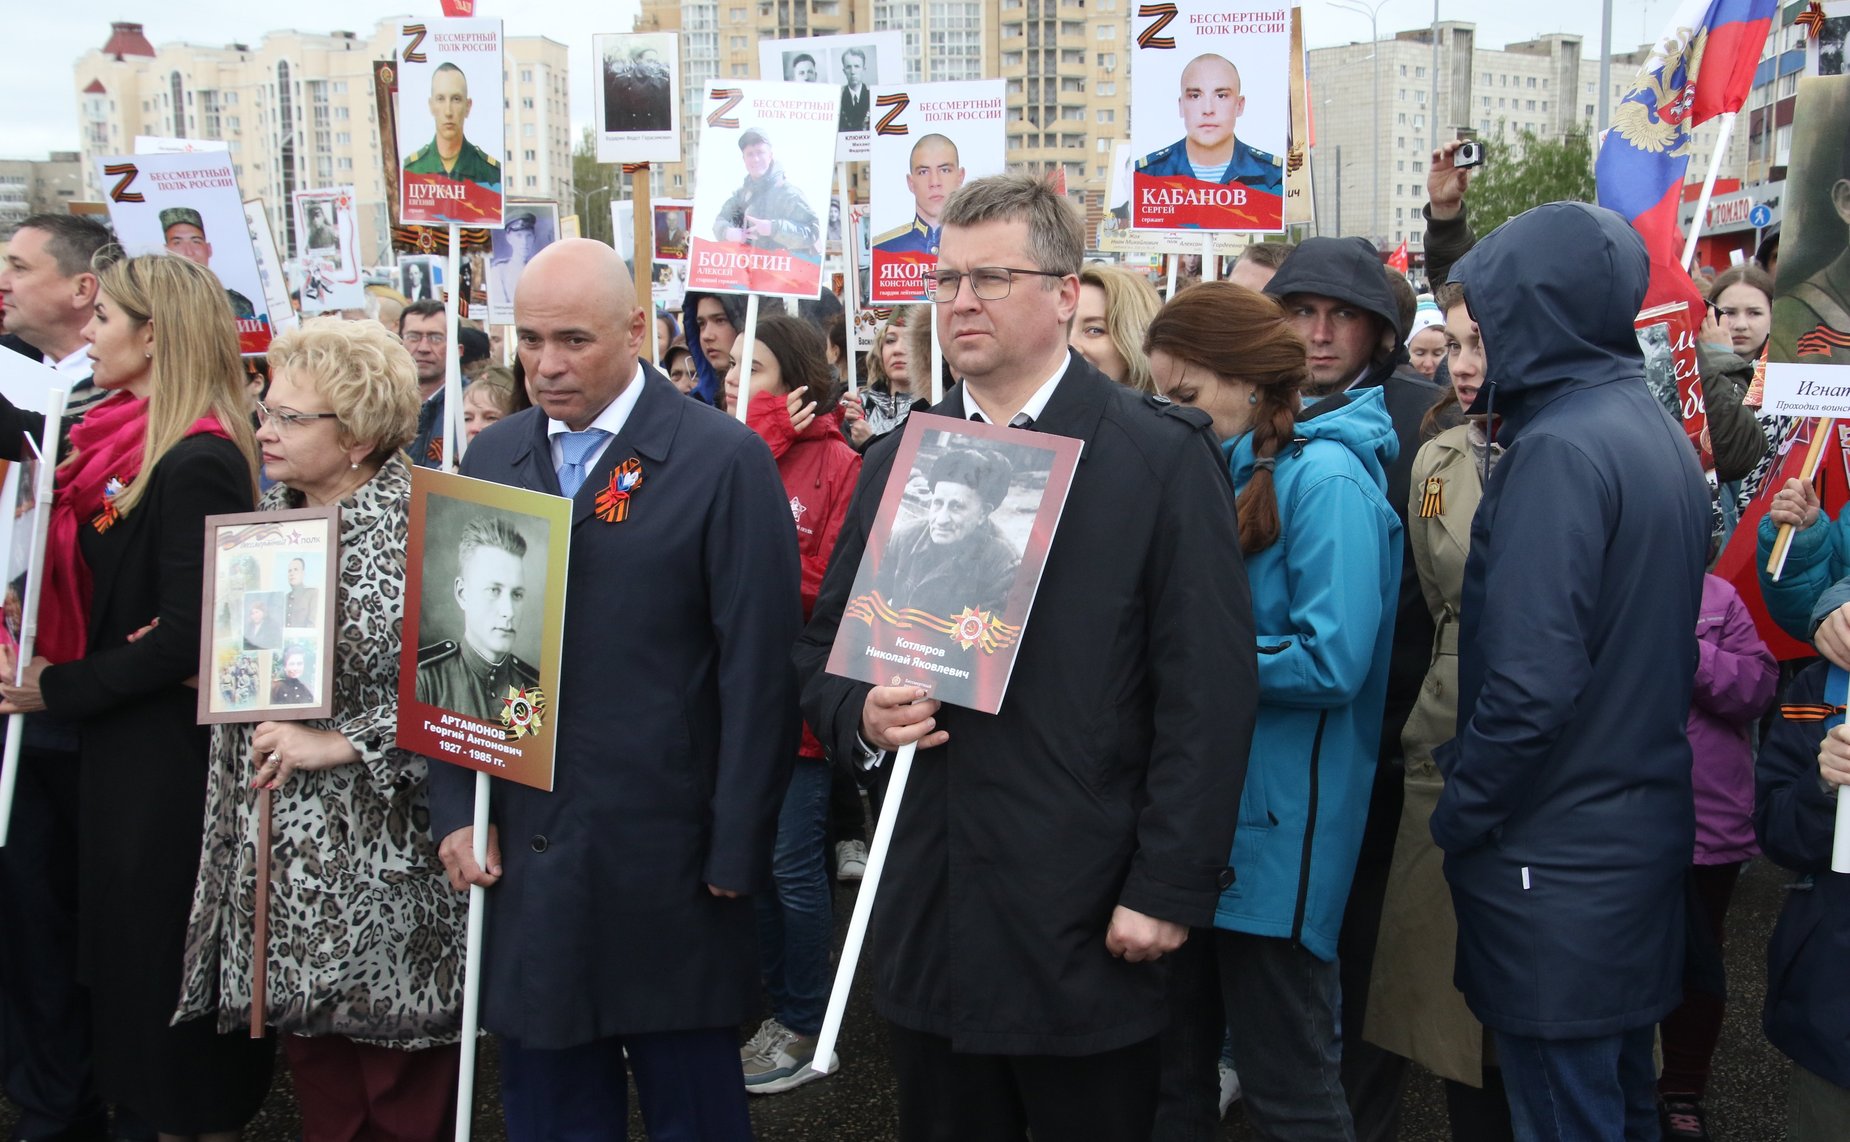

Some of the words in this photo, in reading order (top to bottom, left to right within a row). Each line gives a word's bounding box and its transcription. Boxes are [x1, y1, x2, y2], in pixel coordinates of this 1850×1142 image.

[1189, 9, 1285, 24] БЕССМЕРТНЫЙ
[1196, 25, 1230, 35] ПОЛК
[1233, 23, 1285, 34] РОССИИ
[434, 32, 497, 42] БЕССМЕРТНЫЙ
[438, 43, 462, 52] ПОЛК
[462, 43, 497, 52] РОССИИ
[753, 98, 834, 111] БЕССМЕРТНЫЙ
[919, 97, 1001, 111] БЕССМЕРТНЫЙ
[758, 109, 787, 120] ПОЛК
[789, 111, 834, 121] РОССИИ
[925, 112, 954, 122] ПОЛК
[956, 110, 1001, 120] РОССИИ
[150, 166, 231, 181] БЕССМЕРТНЫЙ
[158, 180, 187, 191] ПОЛК
[189, 178, 233, 189] РОССИИ
[408, 183, 466, 199] ЦУРКАН
[1141, 188, 1247, 206] КАБАНОВ
[1141, 205, 1175, 214] СЕРГЕЙ
[698, 251, 792, 272] БОЛОТИН
[696, 267, 733, 277] АЛЕКСЕЙ
[1776, 401, 1819, 411] Проходил
[895, 636, 946, 657] Котляров
[865, 645, 911, 665] Николай
[912, 656, 970, 680] Яковлевич
[440, 714, 506, 740] АРТАМОНОВ
[424, 720, 465, 740] Георгий
[466, 734, 523, 756] Антонович
[439, 740, 462, 754] 1927
[468, 749, 492, 763] 1985
[493, 758, 506, 767] гг.
